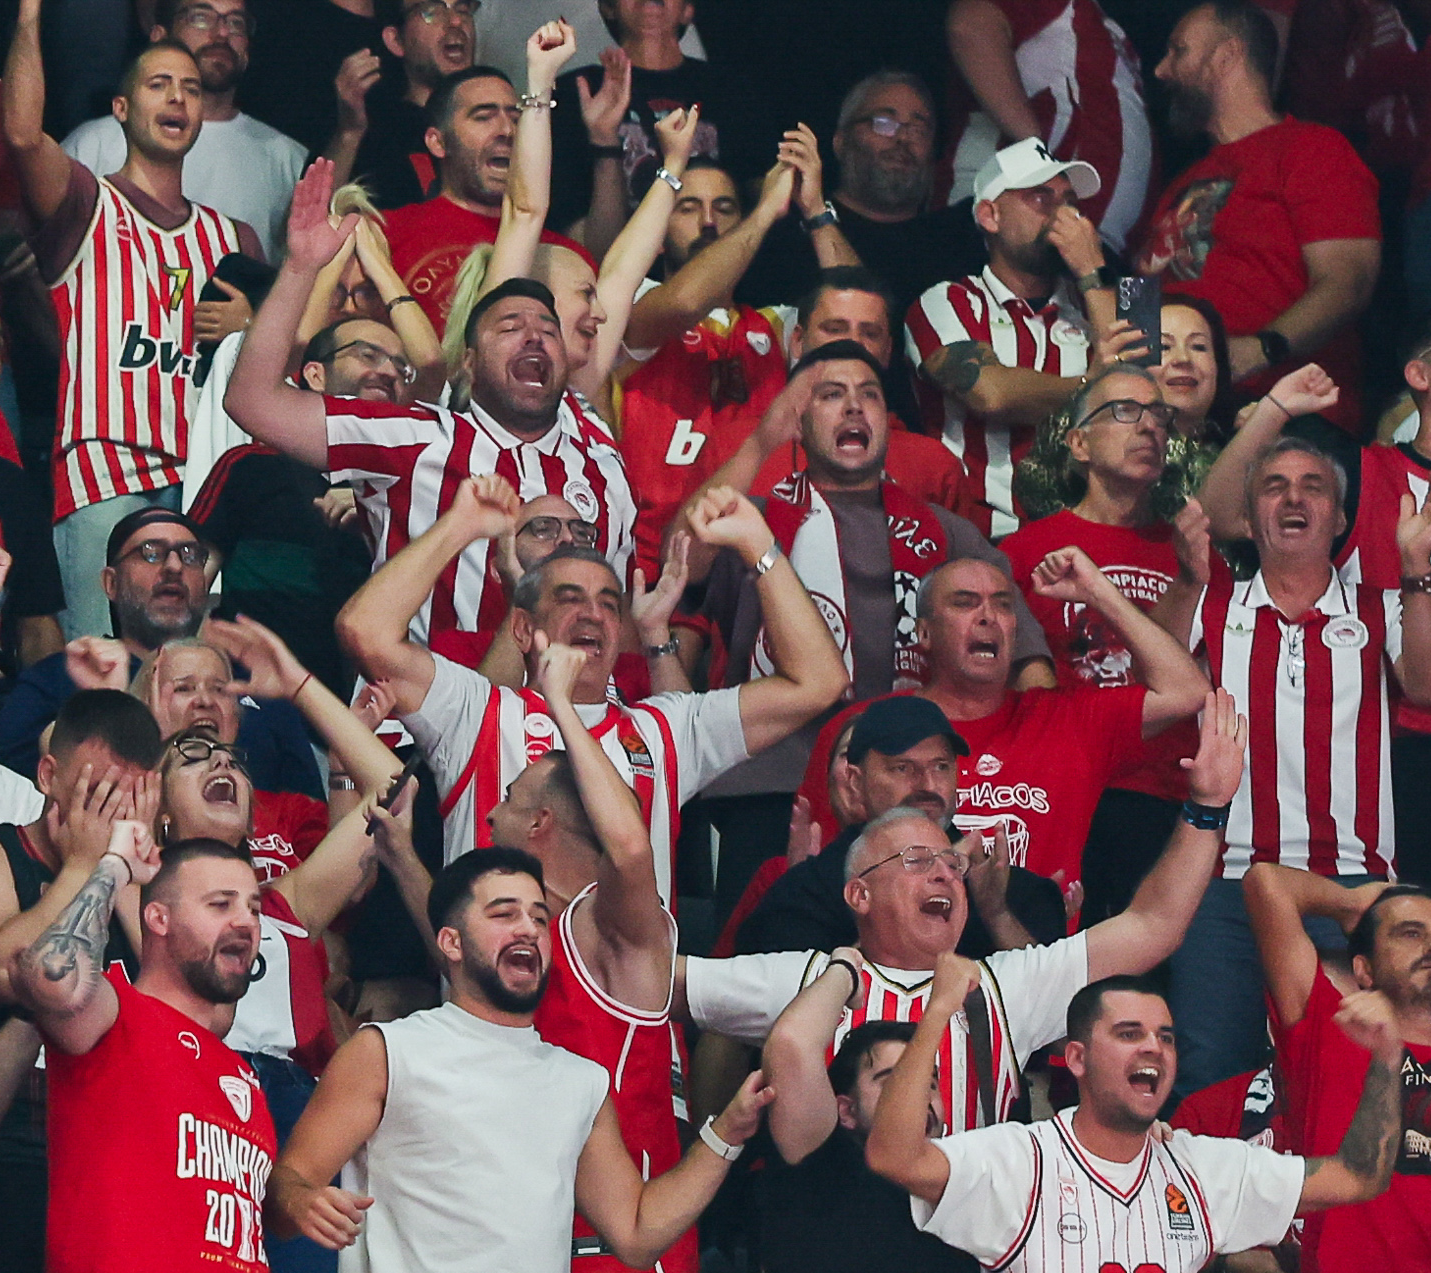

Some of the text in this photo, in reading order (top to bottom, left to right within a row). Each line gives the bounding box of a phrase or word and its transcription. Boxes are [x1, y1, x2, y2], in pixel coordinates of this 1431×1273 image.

[164, 264, 191, 311] 7
[1103, 572, 1169, 596] MPIACO
[205, 1189, 236, 1248] 20
